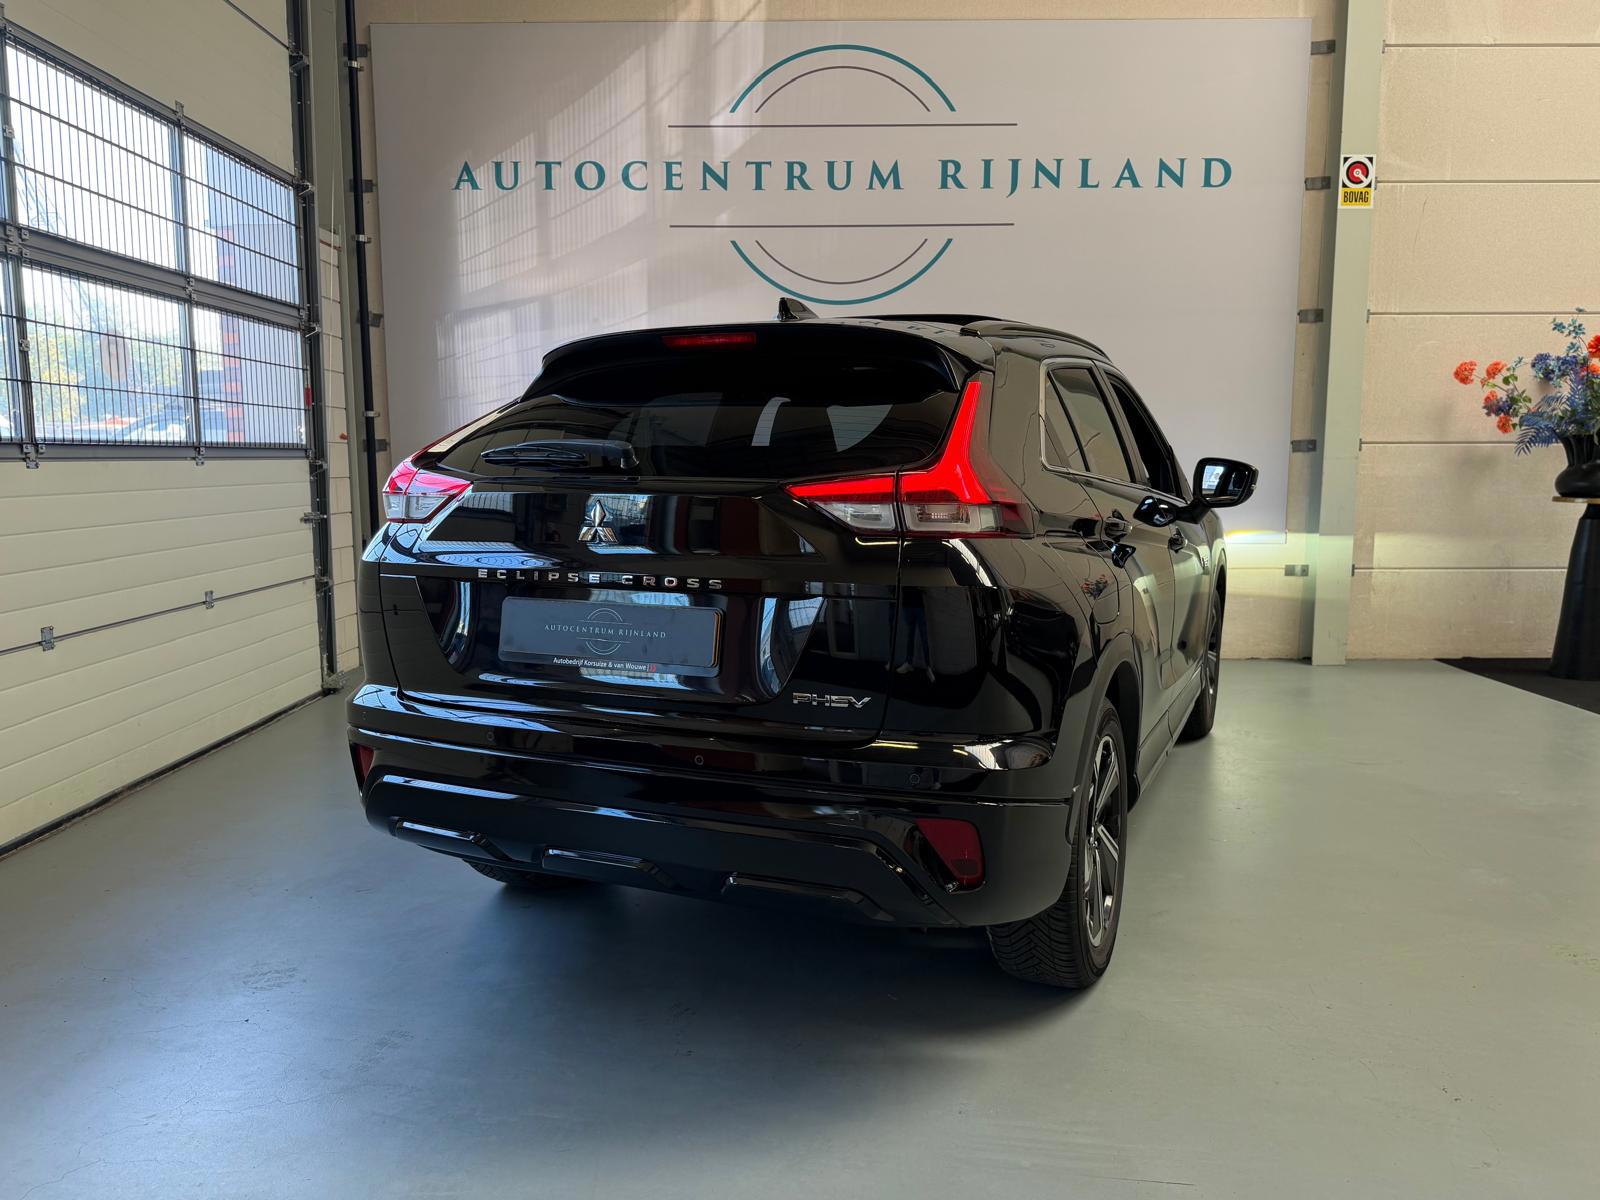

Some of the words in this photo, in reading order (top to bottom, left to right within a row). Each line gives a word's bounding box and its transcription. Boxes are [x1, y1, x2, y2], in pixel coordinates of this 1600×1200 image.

[452, 159, 905, 193] AUTOCENTRUM
[939, 156, 1236, 199] RIJNLAND
[1343, 190, 1369, 203] BOVAG
[477, 568, 600, 583] ECLIPSE
[621, 575, 722, 590] CROSS
[544, 623, 615, 636] AUTOCENTRUM
[618, 627, 667, 639] RIJNLAND
[553, 656, 583, 668] Autobedrijf
[608, 660, 613, 669] &
[625, 662, 647, 671] Wouwe
[792, 692, 872, 708] PHEV
